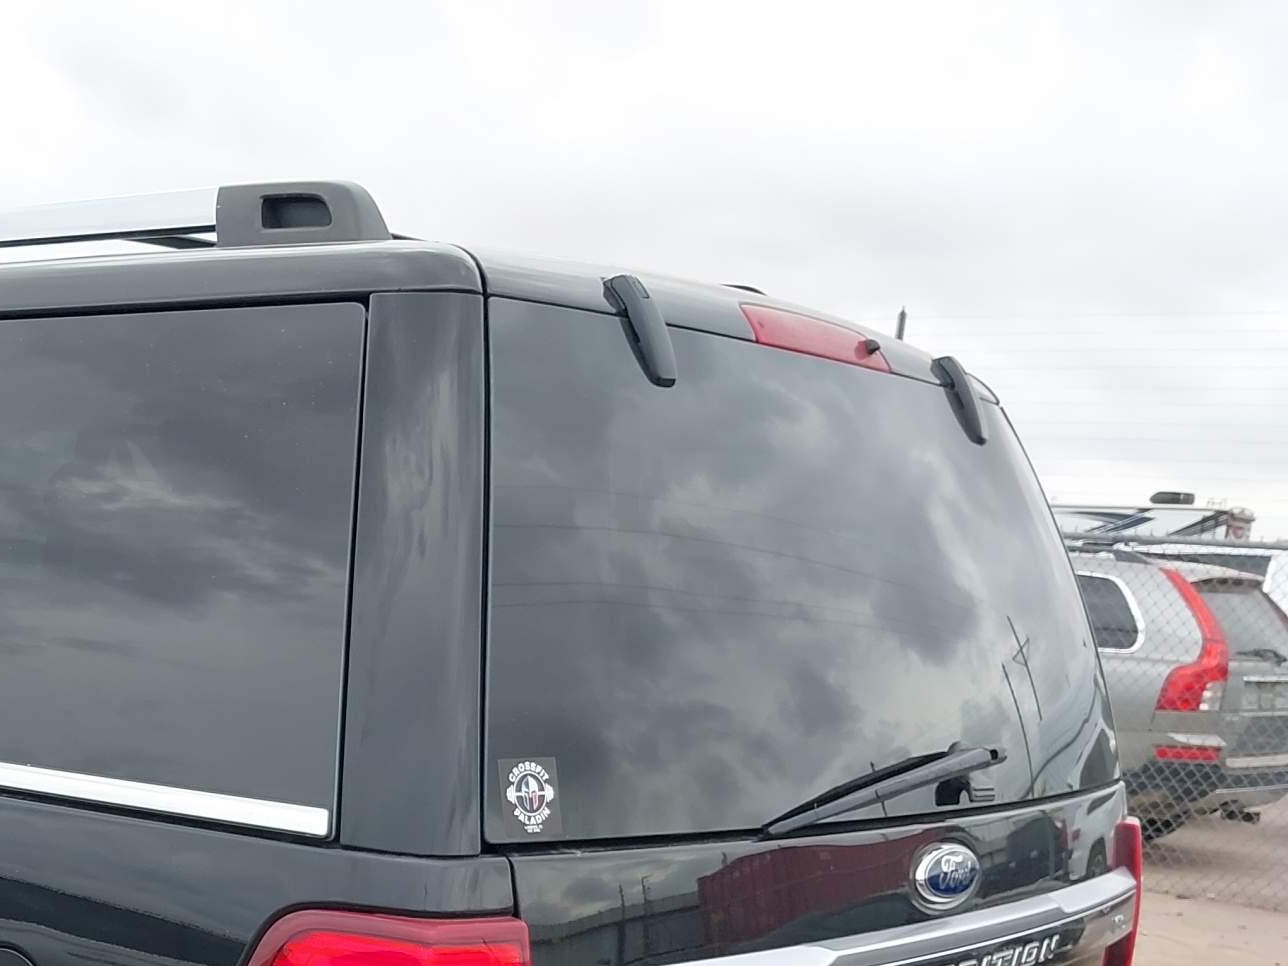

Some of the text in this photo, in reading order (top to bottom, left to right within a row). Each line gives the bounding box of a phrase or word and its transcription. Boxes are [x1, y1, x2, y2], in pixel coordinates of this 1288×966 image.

[508, 761, 550, 782] CROSSFIT
[514, 806, 551, 825] PALADIN
[939, 854, 973, 890] Ford
